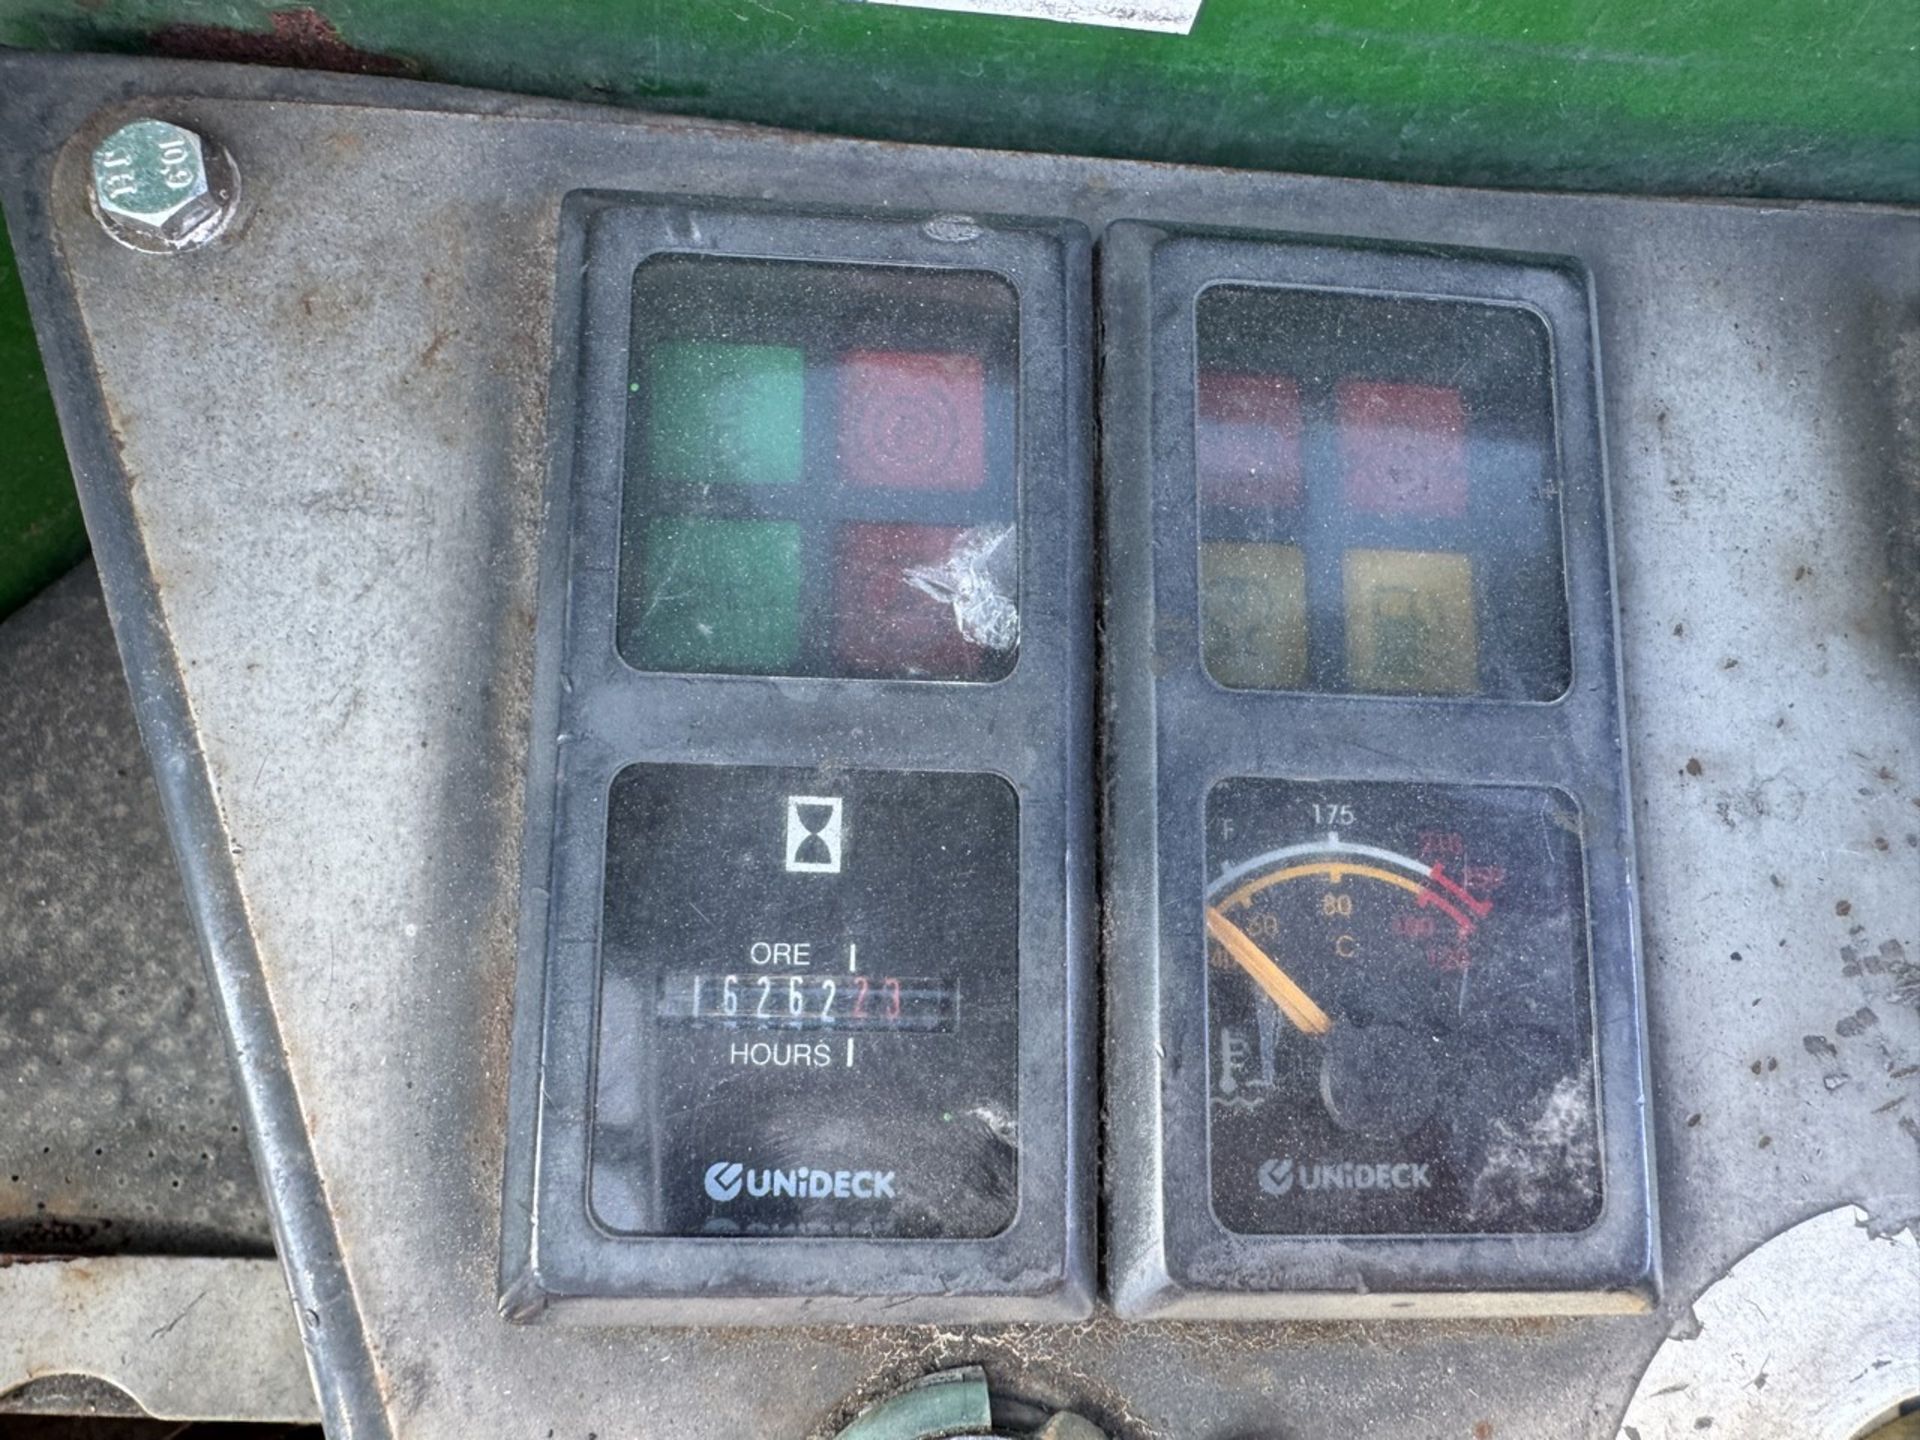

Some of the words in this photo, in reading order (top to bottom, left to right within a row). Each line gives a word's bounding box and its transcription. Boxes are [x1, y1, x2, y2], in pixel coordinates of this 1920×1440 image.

[1312, 803, 1356, 825] 175
[750, 942, 811, 965] ORE
[1336, 934, 1356, 958] C
[731, 1042, 832, 1067] HOURS
